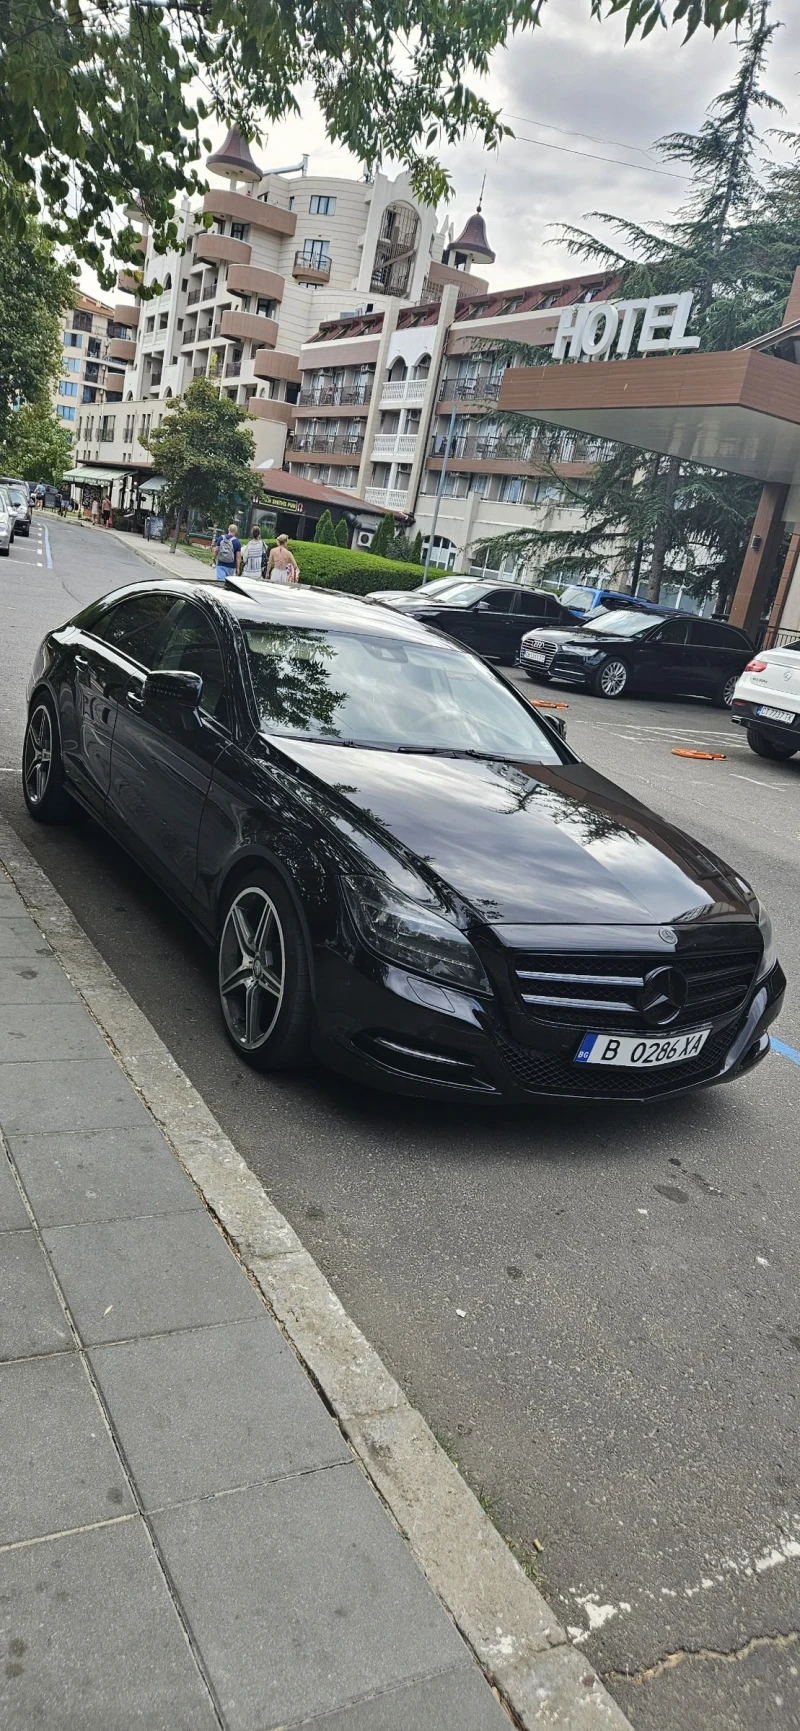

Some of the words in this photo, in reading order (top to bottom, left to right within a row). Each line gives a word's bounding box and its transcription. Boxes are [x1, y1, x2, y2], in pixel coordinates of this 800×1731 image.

[552, 291, 701, 360] HOTEL
[769, 709, 785, 719] 7737
[578, 1051, 589, 1059] BG
[601, 1039, 621, 1060] B
[630, 1039, 681, 1063] 0286
[678, 1033, 703, 1057] XA
